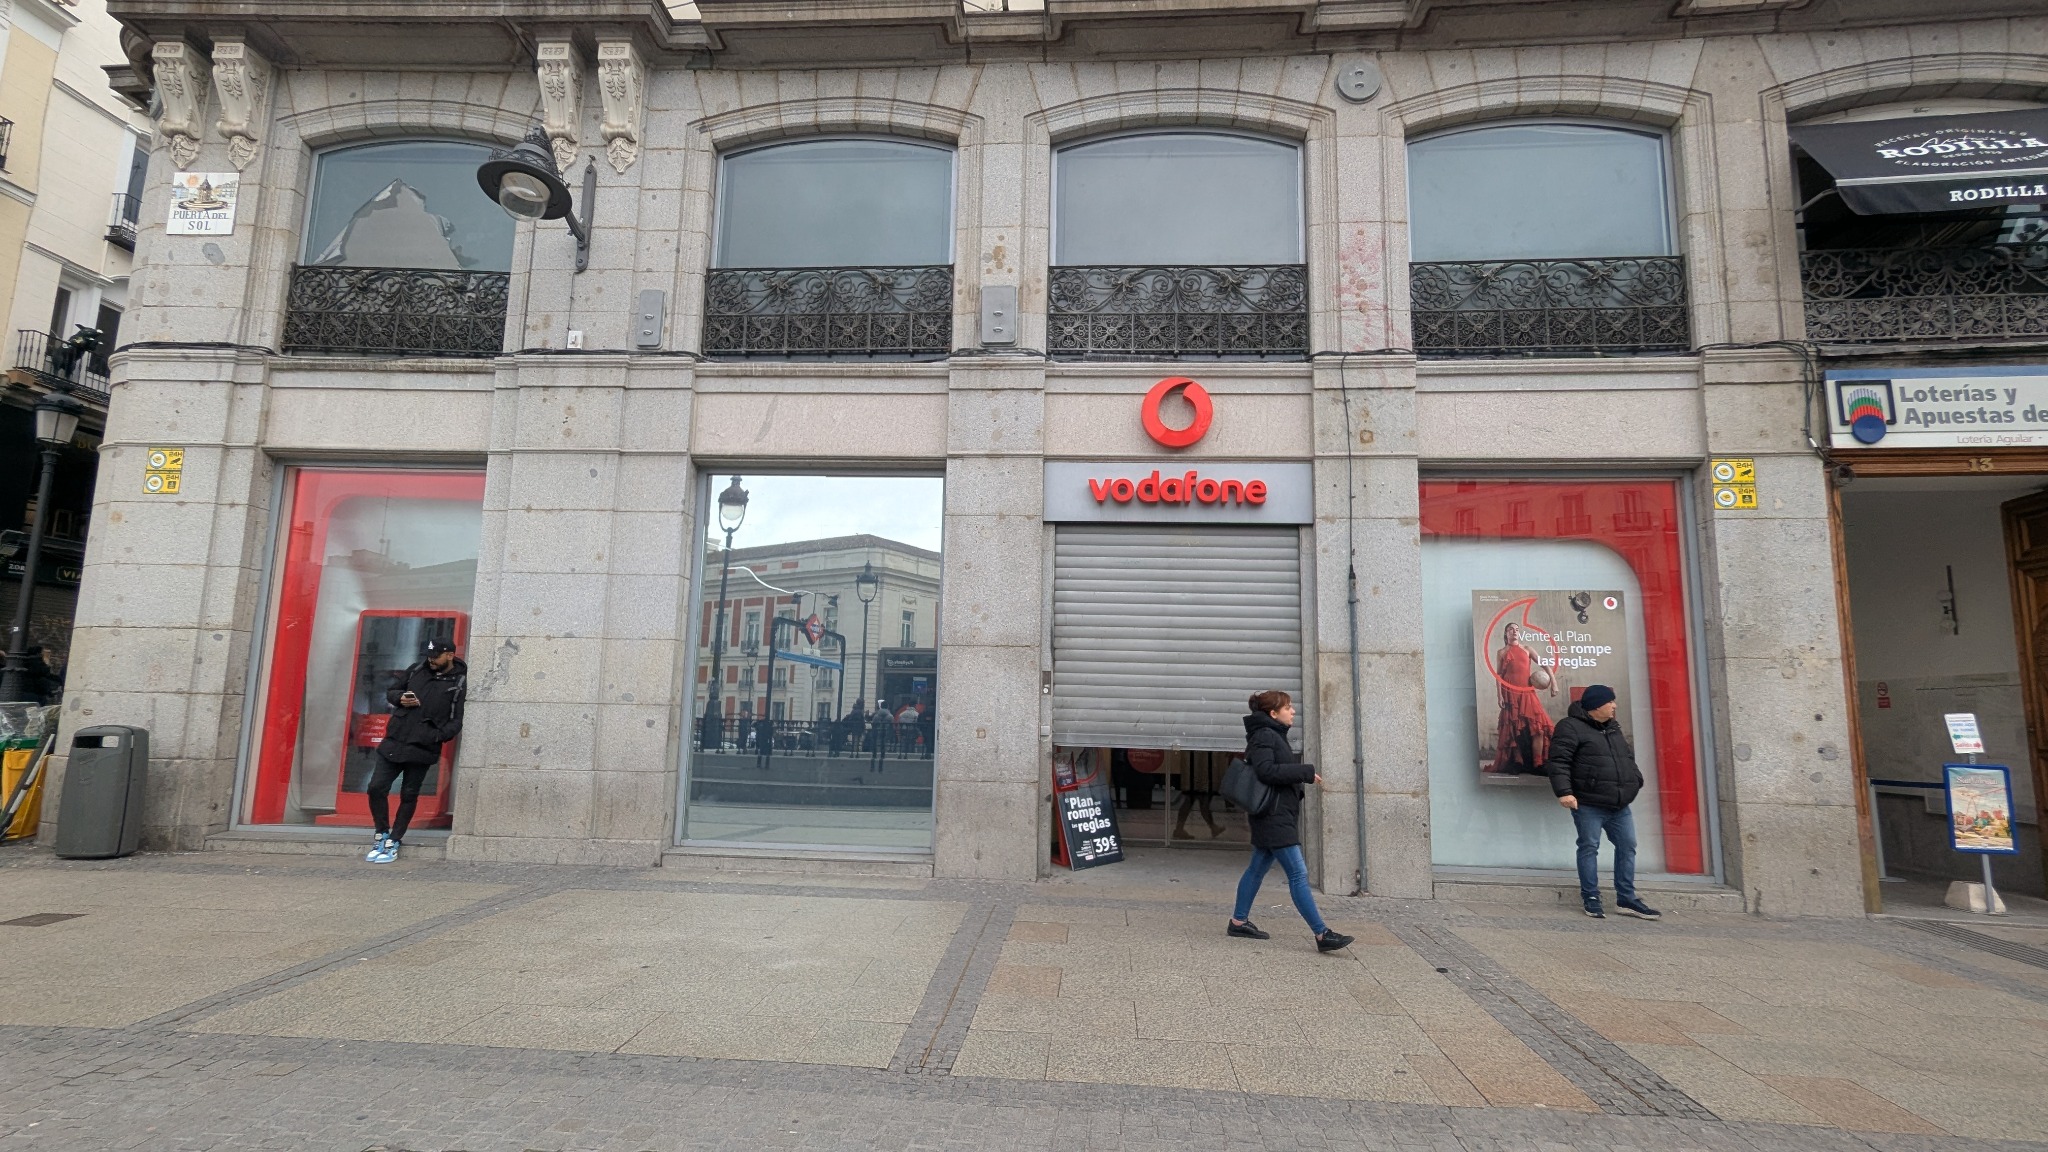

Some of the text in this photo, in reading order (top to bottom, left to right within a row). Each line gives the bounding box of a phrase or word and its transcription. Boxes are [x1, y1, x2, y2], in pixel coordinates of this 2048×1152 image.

[1874, 128, 2028, 147] RECETAS ORIGINALES
[1876, 138, 2048, 158] RODILLA
[1949, 184, 2047, 202] RODILLA
[173, 210, 210, 219] PUERTA
[188, 220, 211, 230] SOL
[1899, 384, 2017, 404] Loterías y
[1904, 407, 2015, 428] Apuestas
[1996, 434, 2033, 445] Aguilar
[1969, 457, 1994, 471] 13
[1088, 470, 1267, 505] vodafone
[1518, 630, 1592, 642] Vente al Plan
[1546, 644, 1612, 656] que rompe
[1537, 655, 1597, 668] las reglas
[1069, 796, 1094, 809] Plan
[1067, 806, 1102, 820] rompe
[1078, 818, 1111, 833] reglas
[1093, 835, 1117, 853] 39€
